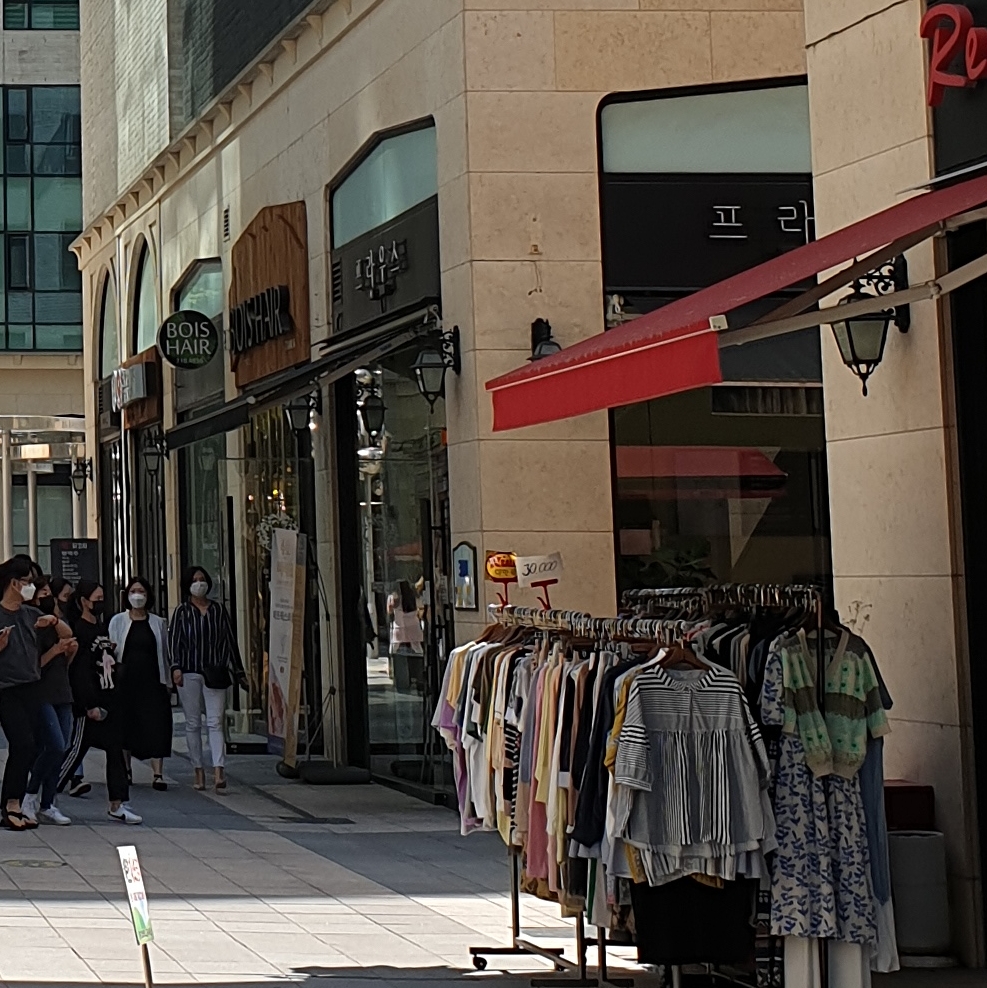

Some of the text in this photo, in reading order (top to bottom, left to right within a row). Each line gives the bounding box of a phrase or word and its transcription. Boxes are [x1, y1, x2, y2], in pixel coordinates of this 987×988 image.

[354, 240, 401, 298] 프라우스
[166, 321, 210, 339] BOIS
[166, 339, 212, 355] HAIR
